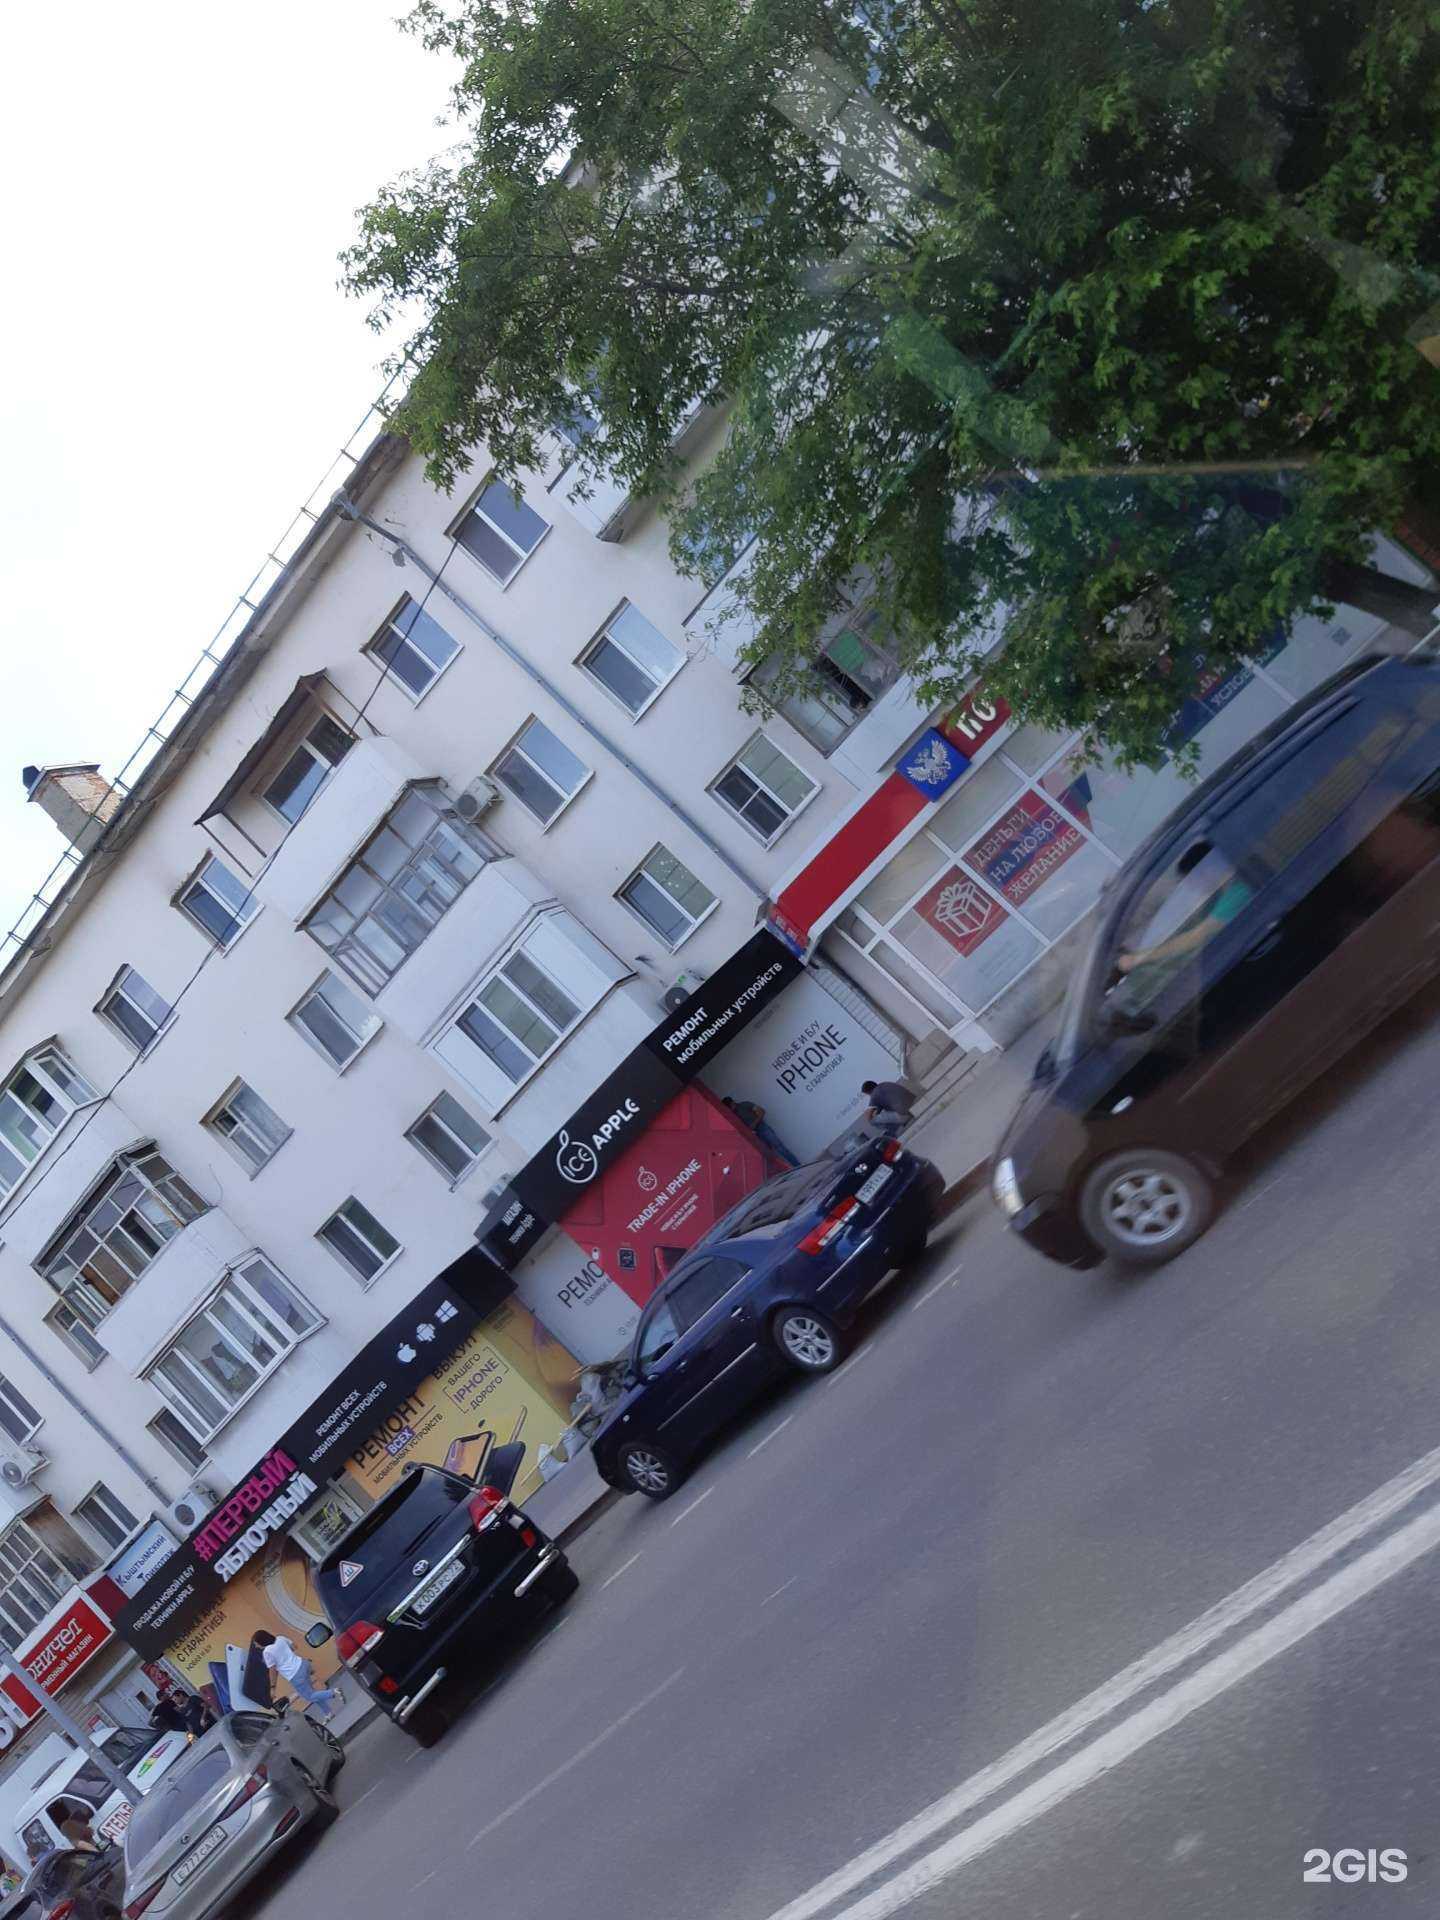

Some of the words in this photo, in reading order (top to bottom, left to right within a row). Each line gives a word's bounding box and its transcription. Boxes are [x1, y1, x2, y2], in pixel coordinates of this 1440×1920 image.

[974, 807, 1029, 867] ДЕНЬГИ
[991, 857, 1016, 882] НА
[1010, 808, 1063, 863] ЛЮБОЕ
[1008, 825, 1081, 899] ЖЕЛАНИЕ
[662, 1006, 709, 1052] РЕМОНТ
[676, 1008, 735, 1064] мобильных
[731, 961, 782, 1012] устройств
[771, 1040, 801, 1071] НОВЫЕ
[797, 1033, 808, 1044] И
[804, 1019, 820, 1038] Б/У
[776, 1024, 846, 1094] IPHONE
[563, 1147, 592, 1177] ICE
[588, 1097, 640, 1150] APPLE
[626, 1191, 668, 1233] TRADE-IN
[665, 1158, 701, 1195] IPHONE
[447, 1352, 481, 1386] ВАШЕГО
[453, 1357, 499, 1403] IPHONE
[469, 1375, 503, 1410] ДОРОГО
[309, 1418, 351, 1462] МОБИЛЬНЫХ
[347, 1380, 387, 1421] УСТРОЙСТВ
[315, 1406, 343, 1436] РЕМОНТ
[340, 1389, 360, 1409] ВСЕХ
[349, 1392, 425, 1468] РЕМОНТ
[388, 1428, 412, 1454] ВСЕХ
[190, 1447, 297, 1562] #ПЕРВЫЙ
[212, 1470, 318, 1582] ЯБЛОЧНЫЙ
[115, 1534, 166, 1586] Кыштымский
[133, 1600, 161, 1630] ПРОДАЖА
[159, 1578, 182, 1602] НОВОЙ
[151, 1601, 178, 1628] ТЕХНИКИ
[175, 1584, 194, 1604] APPLE
[40, 1659, 68, 1689] РМЕННЫЙ
[66, 1633, 93, 1662] МАГАЗИН
[176, 1653, 186, 1662] С
[183, 1610, 226, 1655] ГАРАНТИЕЙ
